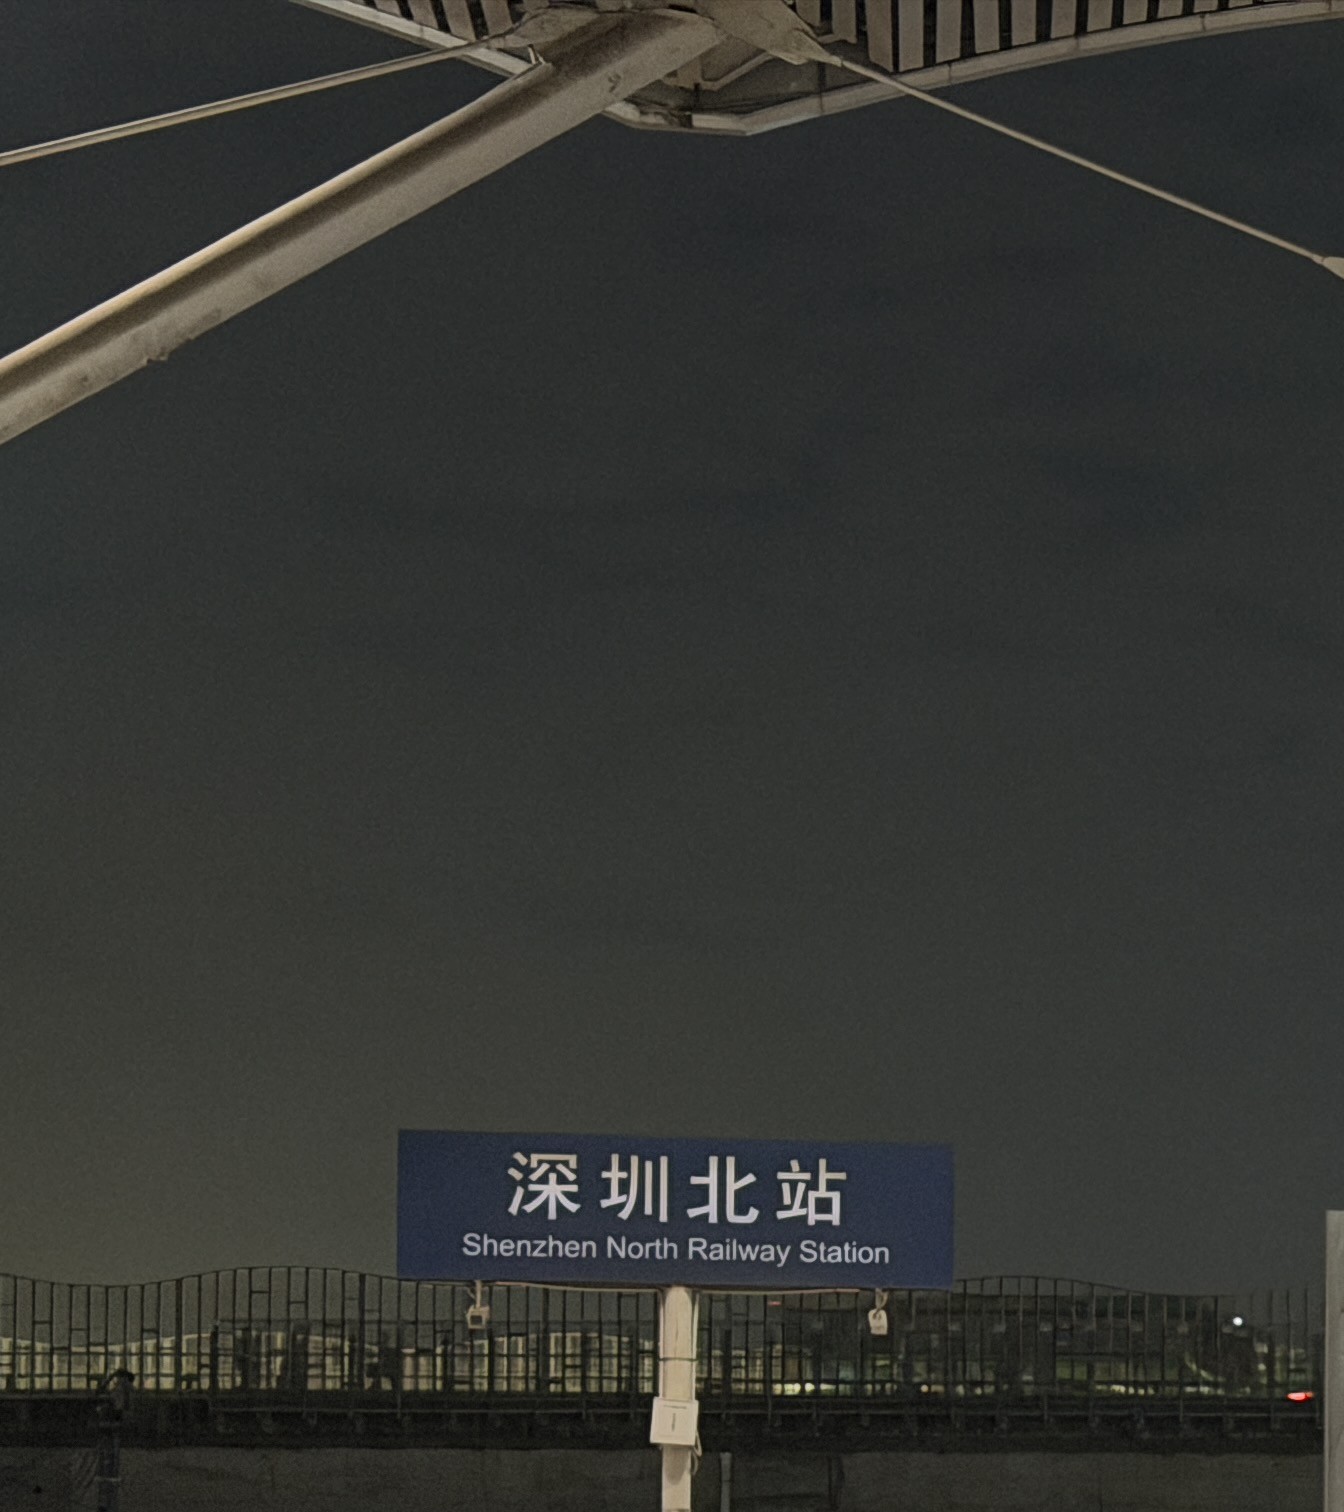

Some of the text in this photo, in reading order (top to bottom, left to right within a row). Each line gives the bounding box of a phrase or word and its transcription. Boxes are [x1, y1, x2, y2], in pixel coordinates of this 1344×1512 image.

[506, 1151, 848, 1227] 深圳北站
[462, 1232, 890, 1268] Shenzhen North Railway Station
